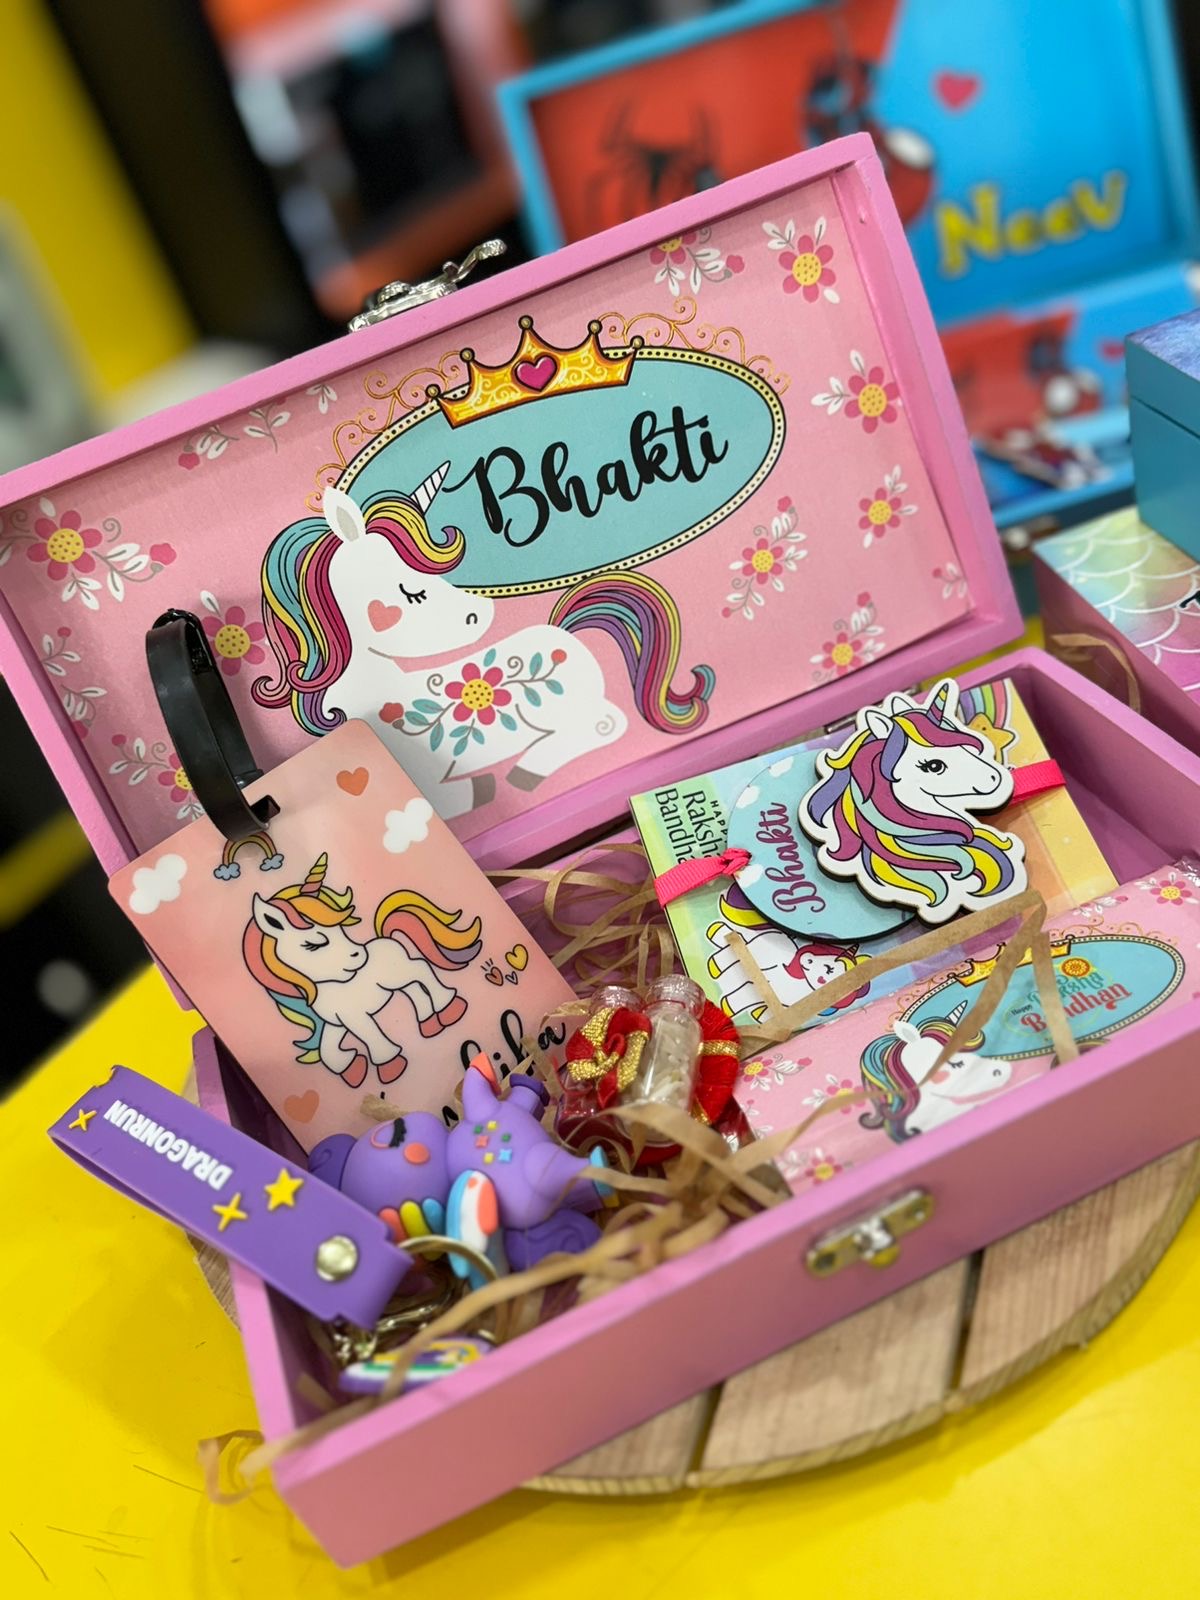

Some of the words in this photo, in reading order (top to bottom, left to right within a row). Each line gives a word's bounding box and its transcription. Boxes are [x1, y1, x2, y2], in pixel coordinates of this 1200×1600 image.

[441, 406, 729, 547] Bhakti
[655, 788, 697, 864] Bandh
[682, 790, 723, 858] Raksh
[710, 800, 728, 844] HAPP
[756, 802, 826, 912] Bhakti
[103, 1099, 233, 1191] DRAGONRUN
